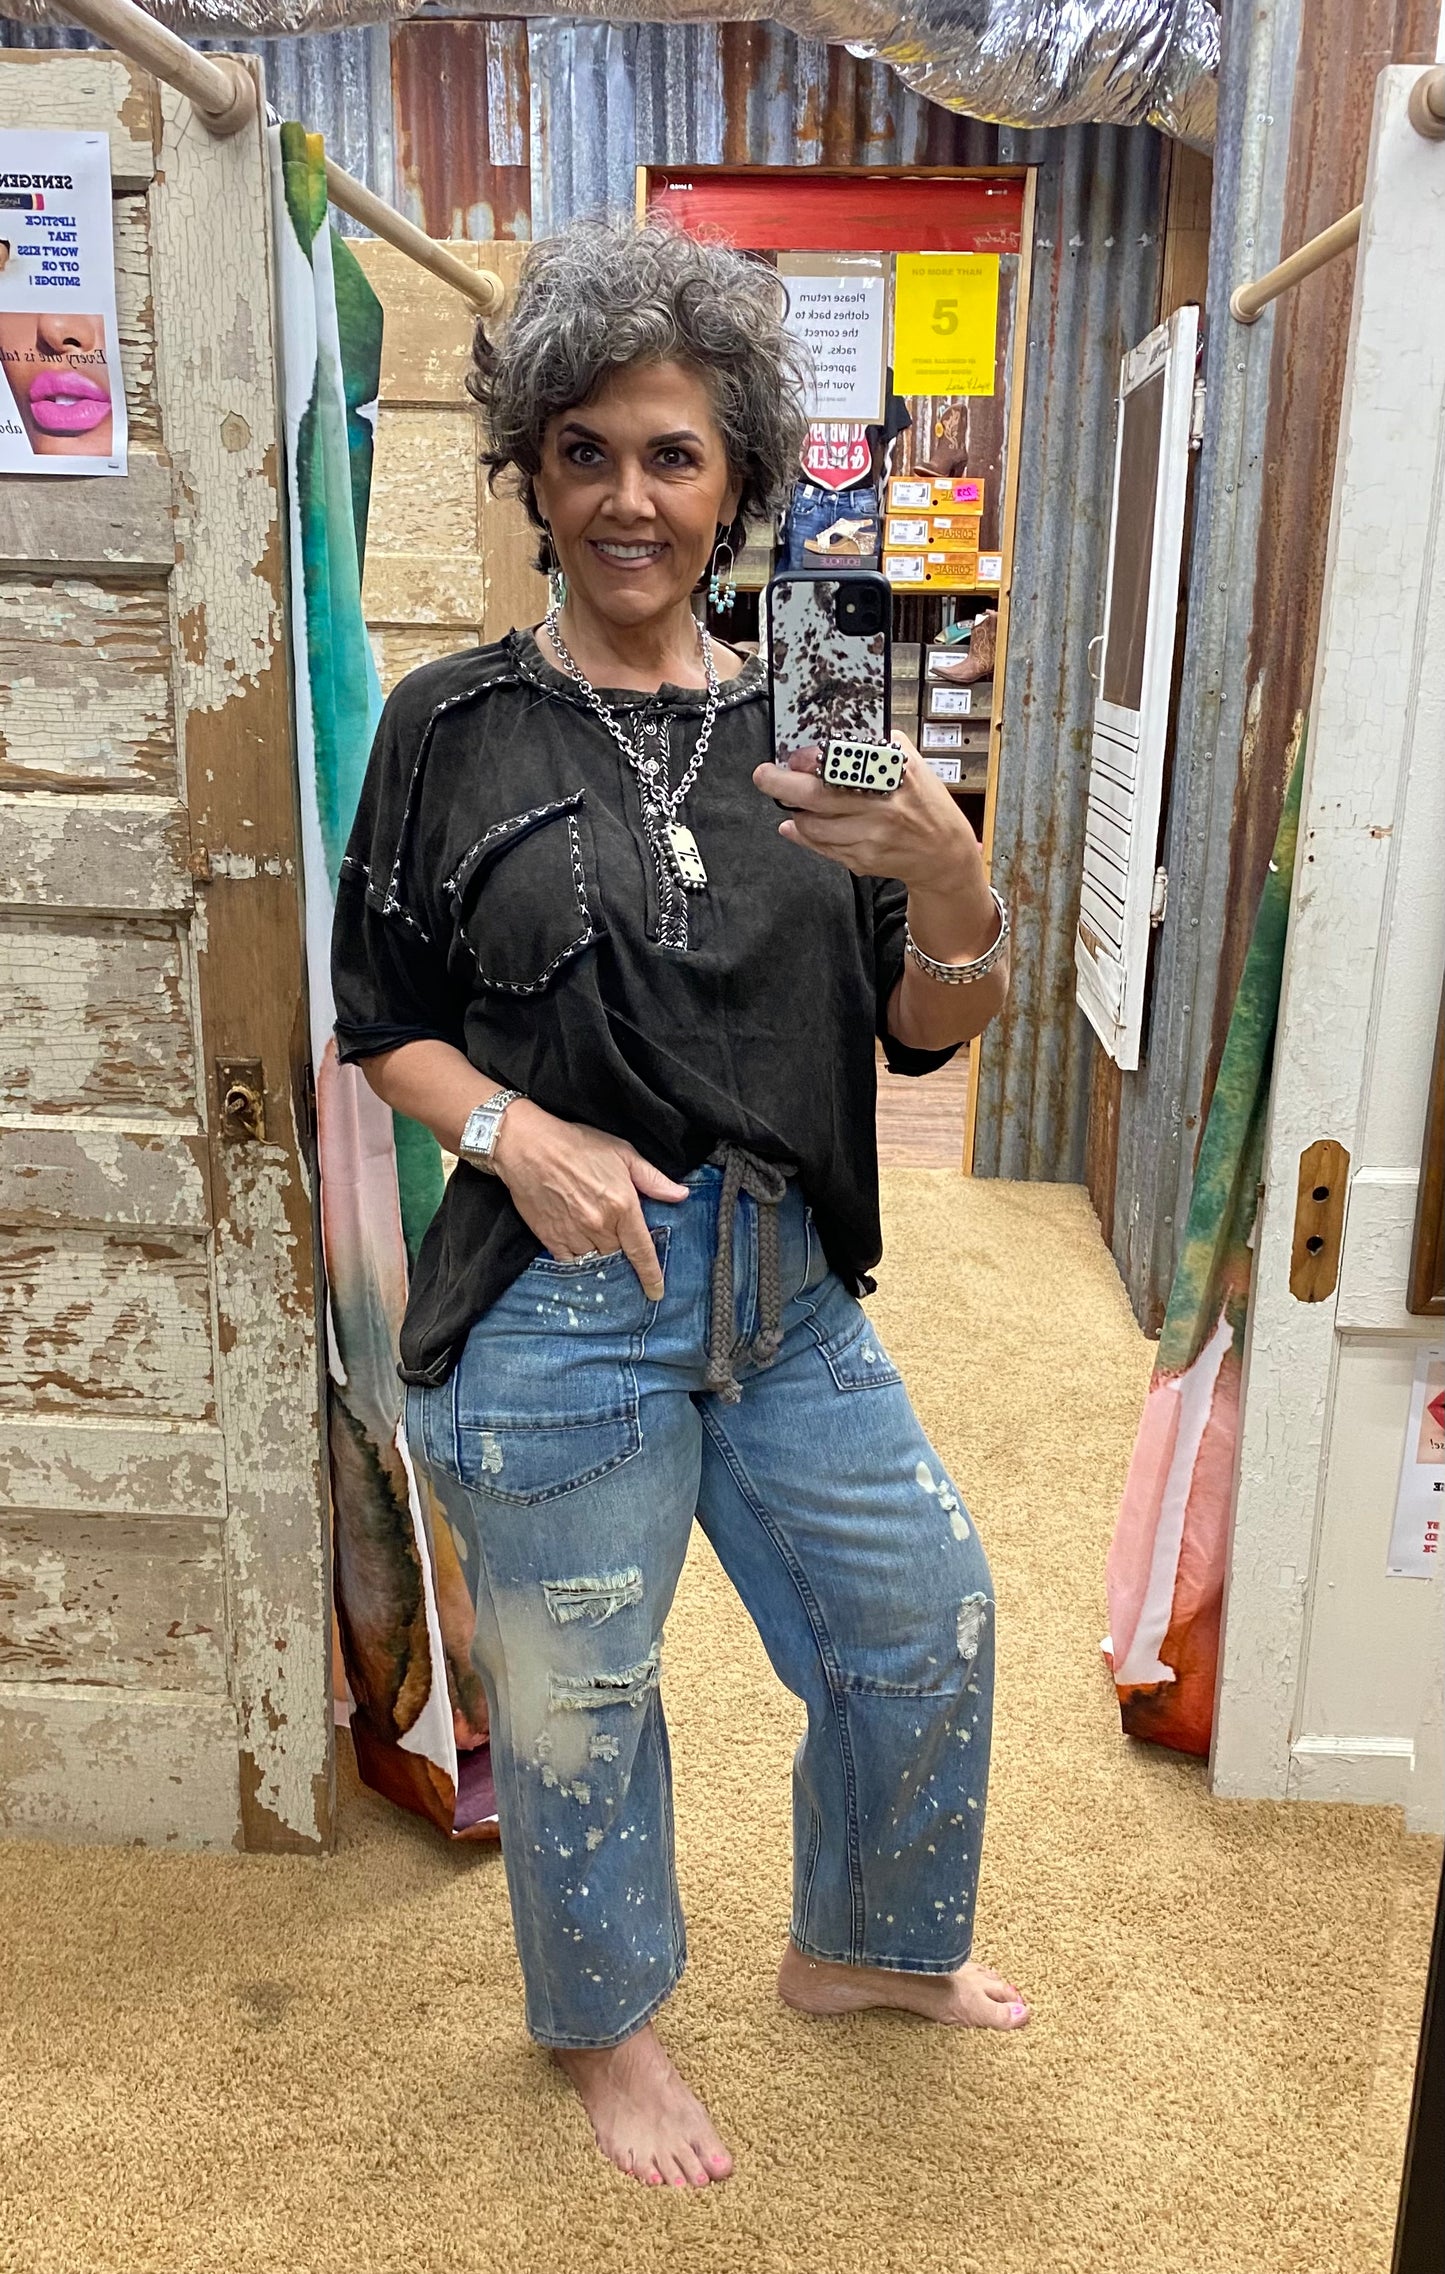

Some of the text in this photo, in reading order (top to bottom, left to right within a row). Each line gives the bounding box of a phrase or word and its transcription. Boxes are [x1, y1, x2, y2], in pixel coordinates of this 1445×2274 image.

[912, 268, 983, 276] NO MORE THAN
[930, 299, 959, 335] 5
